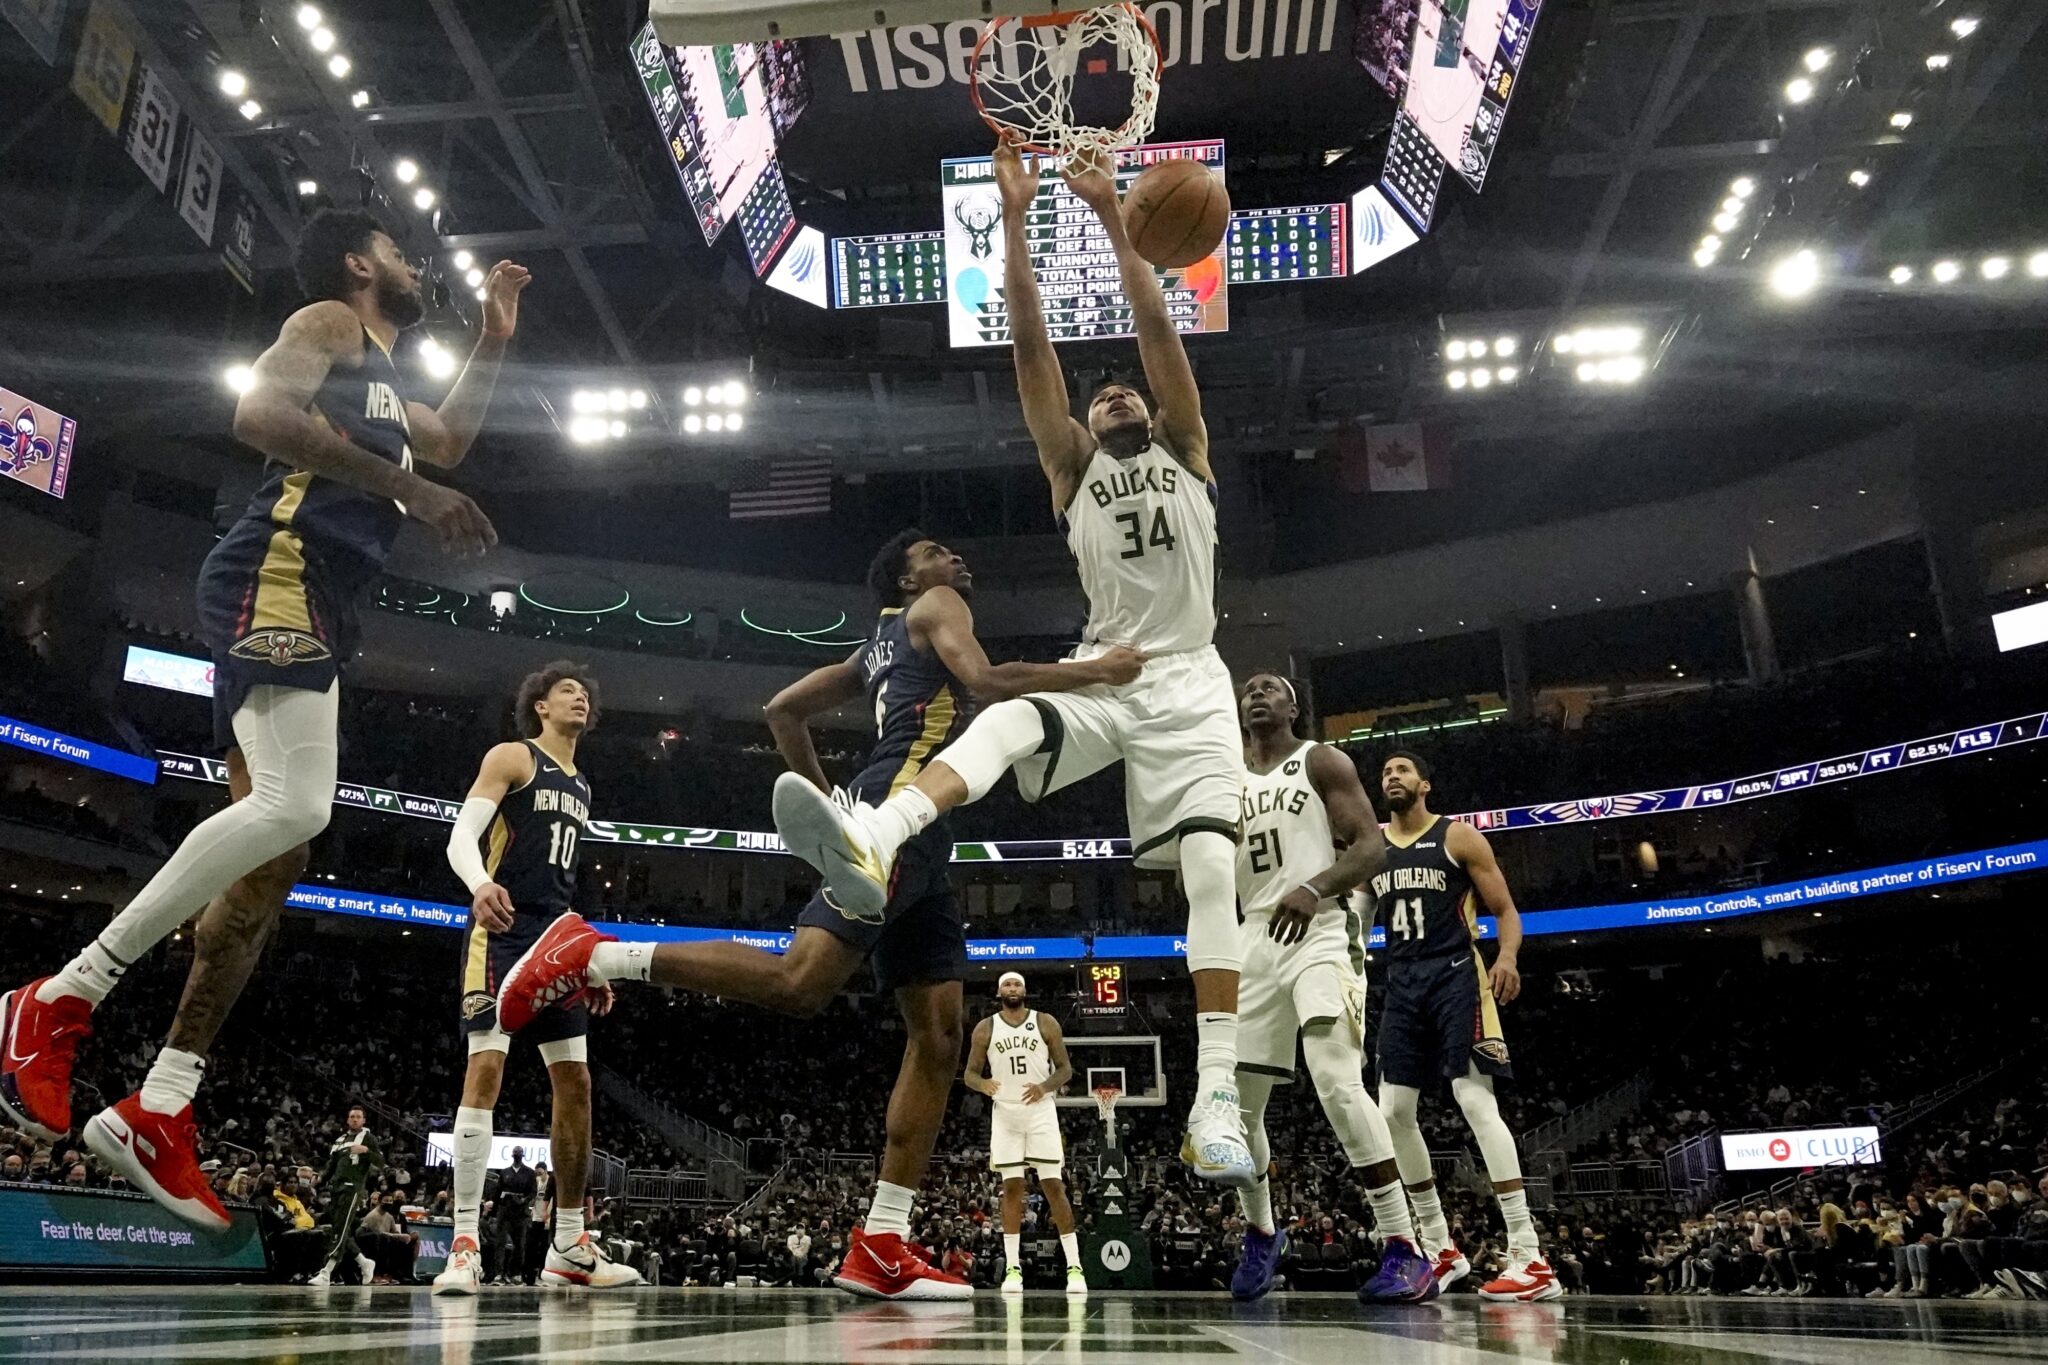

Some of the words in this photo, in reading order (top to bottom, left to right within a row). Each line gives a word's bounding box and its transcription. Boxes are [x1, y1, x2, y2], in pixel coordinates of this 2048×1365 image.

[1504, 13, 1521, 43] 44
[1498, 72, 1512, 100] 2ND
[662, 84, 677, 112] 46
[1476, 106, 1492, 134] 46
[142, 100, 169, 164] 31
[672, 137, 685, 161] 2ND
[192, 163, 212, 212] 3
[694, 168, 707, 193] 44
[1030, 215, 1038, 224] 4
[1232, 222, 1240, 230] 5
[1251, 220, 1259, 229] 4
[1272, 219, 1277, 228] 1
[1290, 218, 1298, 226] 0
[1308, 216, 1316, 225] 2
[1031, 229, 1038, 238] 0
[1056, 227, 1082, 238] OFF
[1233, 234, 1241, 243] 6
[1252, 233, 1259, 242] 7
[1272, 232, 1277, 240] 1
[1290, 230, 1298, 239] 0
[1310, 229, 1316, 238] 1
[860, 247, 866, 255] 7
[878, 246, 885, 254] 5
[896, 244, 903, 253] 2
[915, 243, 920, 251] 1
[933, 242, 938, 250] 1
[1030, 243, 1041, 252] 17
[1056, 241, 1083, 252] DEF
[1231, 247, 1243, 256] 10
[1252, 246, 1260, 254] 6
[1271, 244, 1279, 253] 0
[1290, 243, 1298, 252] 0
[1309, 242, 1317, 251] 0
[858, 259, 870, 268] 13
[878, 258, 886, 266] 6
[897, 257, 902, 265] 1
[914, 255, 921, 264] 0
[932, 254, 939, 263] 0
[1232, 260, 1244, 268] 31
[1254, 258, 1259, 267] 1
[1271, 257, 1279, 266] 3
[1292, 256, 1297, 265] 1
[1309, 255, 1317, 263] 0
[859, 271, 870, 280] 15
[880, 270, 886, 278] 2
[897, 269, 904, 277] 4
[915, 268, 922, 276] 0
[934, 267, 939, 275] 1
[1041, 270, 1084, 282] TOTAL
[1232, 272, 1244, 281] 41
[1253, 271, 1260, 279] 6
[1272, 270, 1279, 278] 3
[1291, 268, 1298, 277] 3
[1309, 267, 1317, 276] 0
[860, 284, 871, 292] 21
[880, 282, 887, 291] 6
[899, 281, 904, 290] 1
[916, 280, 923, 289] 2
[934, 279, 941, 287] 0
[859, 296, 873, 304] 34
[878, 295, 890, 303] 13
[898, 294, 905, 302] 7
[916, 292, 923, 301] 4
[936, 291, 940, 300] 1
[1078, 297, 1096, 308] FG
[1112, 296, 1123, 304] 16
[1074, 311, 1101, 322] 3PT
[1115, 310, 1121, 318] 7
[1080, 326, 1097, 336] FT
[1089, 466, 1176, 509] BUCKS
[1116, 506, 1175, 560] 34
[864, 640, 894, 682] JONES
[12, 727, 50, 748] Fiserv
[53, 738, 90, 760] Forum
[178, 762, 194, 772] PM
[1702, 788, 1723, 801] FG
[1734, 780, 1771, 795] 40.0%
[1780, 770, 1810, 786] 3PT
[1820, 762, 1858, 778] 35.0%
[1871, 752, 1892, 767] FT
[1908, 743, 1950, 759] 62.5%
[1959, 731, 1992, 748] FLS
[2016, 726, 2023, 736] 1
[338, 789, 365, 801] 47.1%
[375, 794, 393, 806] FT
[405, 800, 437, 814] 80.0%
[445, 805, 459, 818] FL
[534, 789, 559, 812] NEW
[1243, 787, 1309, 822] UCKS
[548, 821, 576, 870] 10
[1062, 841, 1113, 858] 5:44
[1248, 828, 1283, 874] 21
[1371, 871, 1391, 899] EW
[1394, 867, 1446, 892] ORLEANS
[1646, 905, 1701, 920] Johnson
[1705, 896, 1761, 914] Controls,
[1765, 889, 1802, 905] smart
[1806, 880, 1858, 898] building
[1862, 872, 1913, 892] partner
[1918, 866, 1933, 880] of
[1936, 860, 1981, 877] Fiserv
[1986, 852, 2036, 869] Forum
[287, 892, 336, 909] owering
[339, 898, 376, 914] smart,
[380, 903, 406, 918] safe,
[411, 906, 452, 924] healthy
[455, 914, 467, 923] an
[1392, 897, 1425, 941] 41
[1000, 943, 1035, 955] Forum
[1092, 966, 1121, 980] 5:43
[1097, 981, 1117, 1003] 15
[995, 1036, 1038, 1054] BUCKS
[1010, 1056, 1027, 1075] 15
[502, 1145, 547, 1161] CUB
[1737, 1148, 1765, 1158] BMO
[1807, 1136, 1867, 1157] CLUB
[41, 1220, 70, 1238] Fear
[73, 1222, 93, 1240] the
[96, 1223, 125, 1241] deer.
[127, 1226, 146, 1242] Get
[150, 1227, 167, 1244] the
[169, 1232, 194, 1247] gear.
